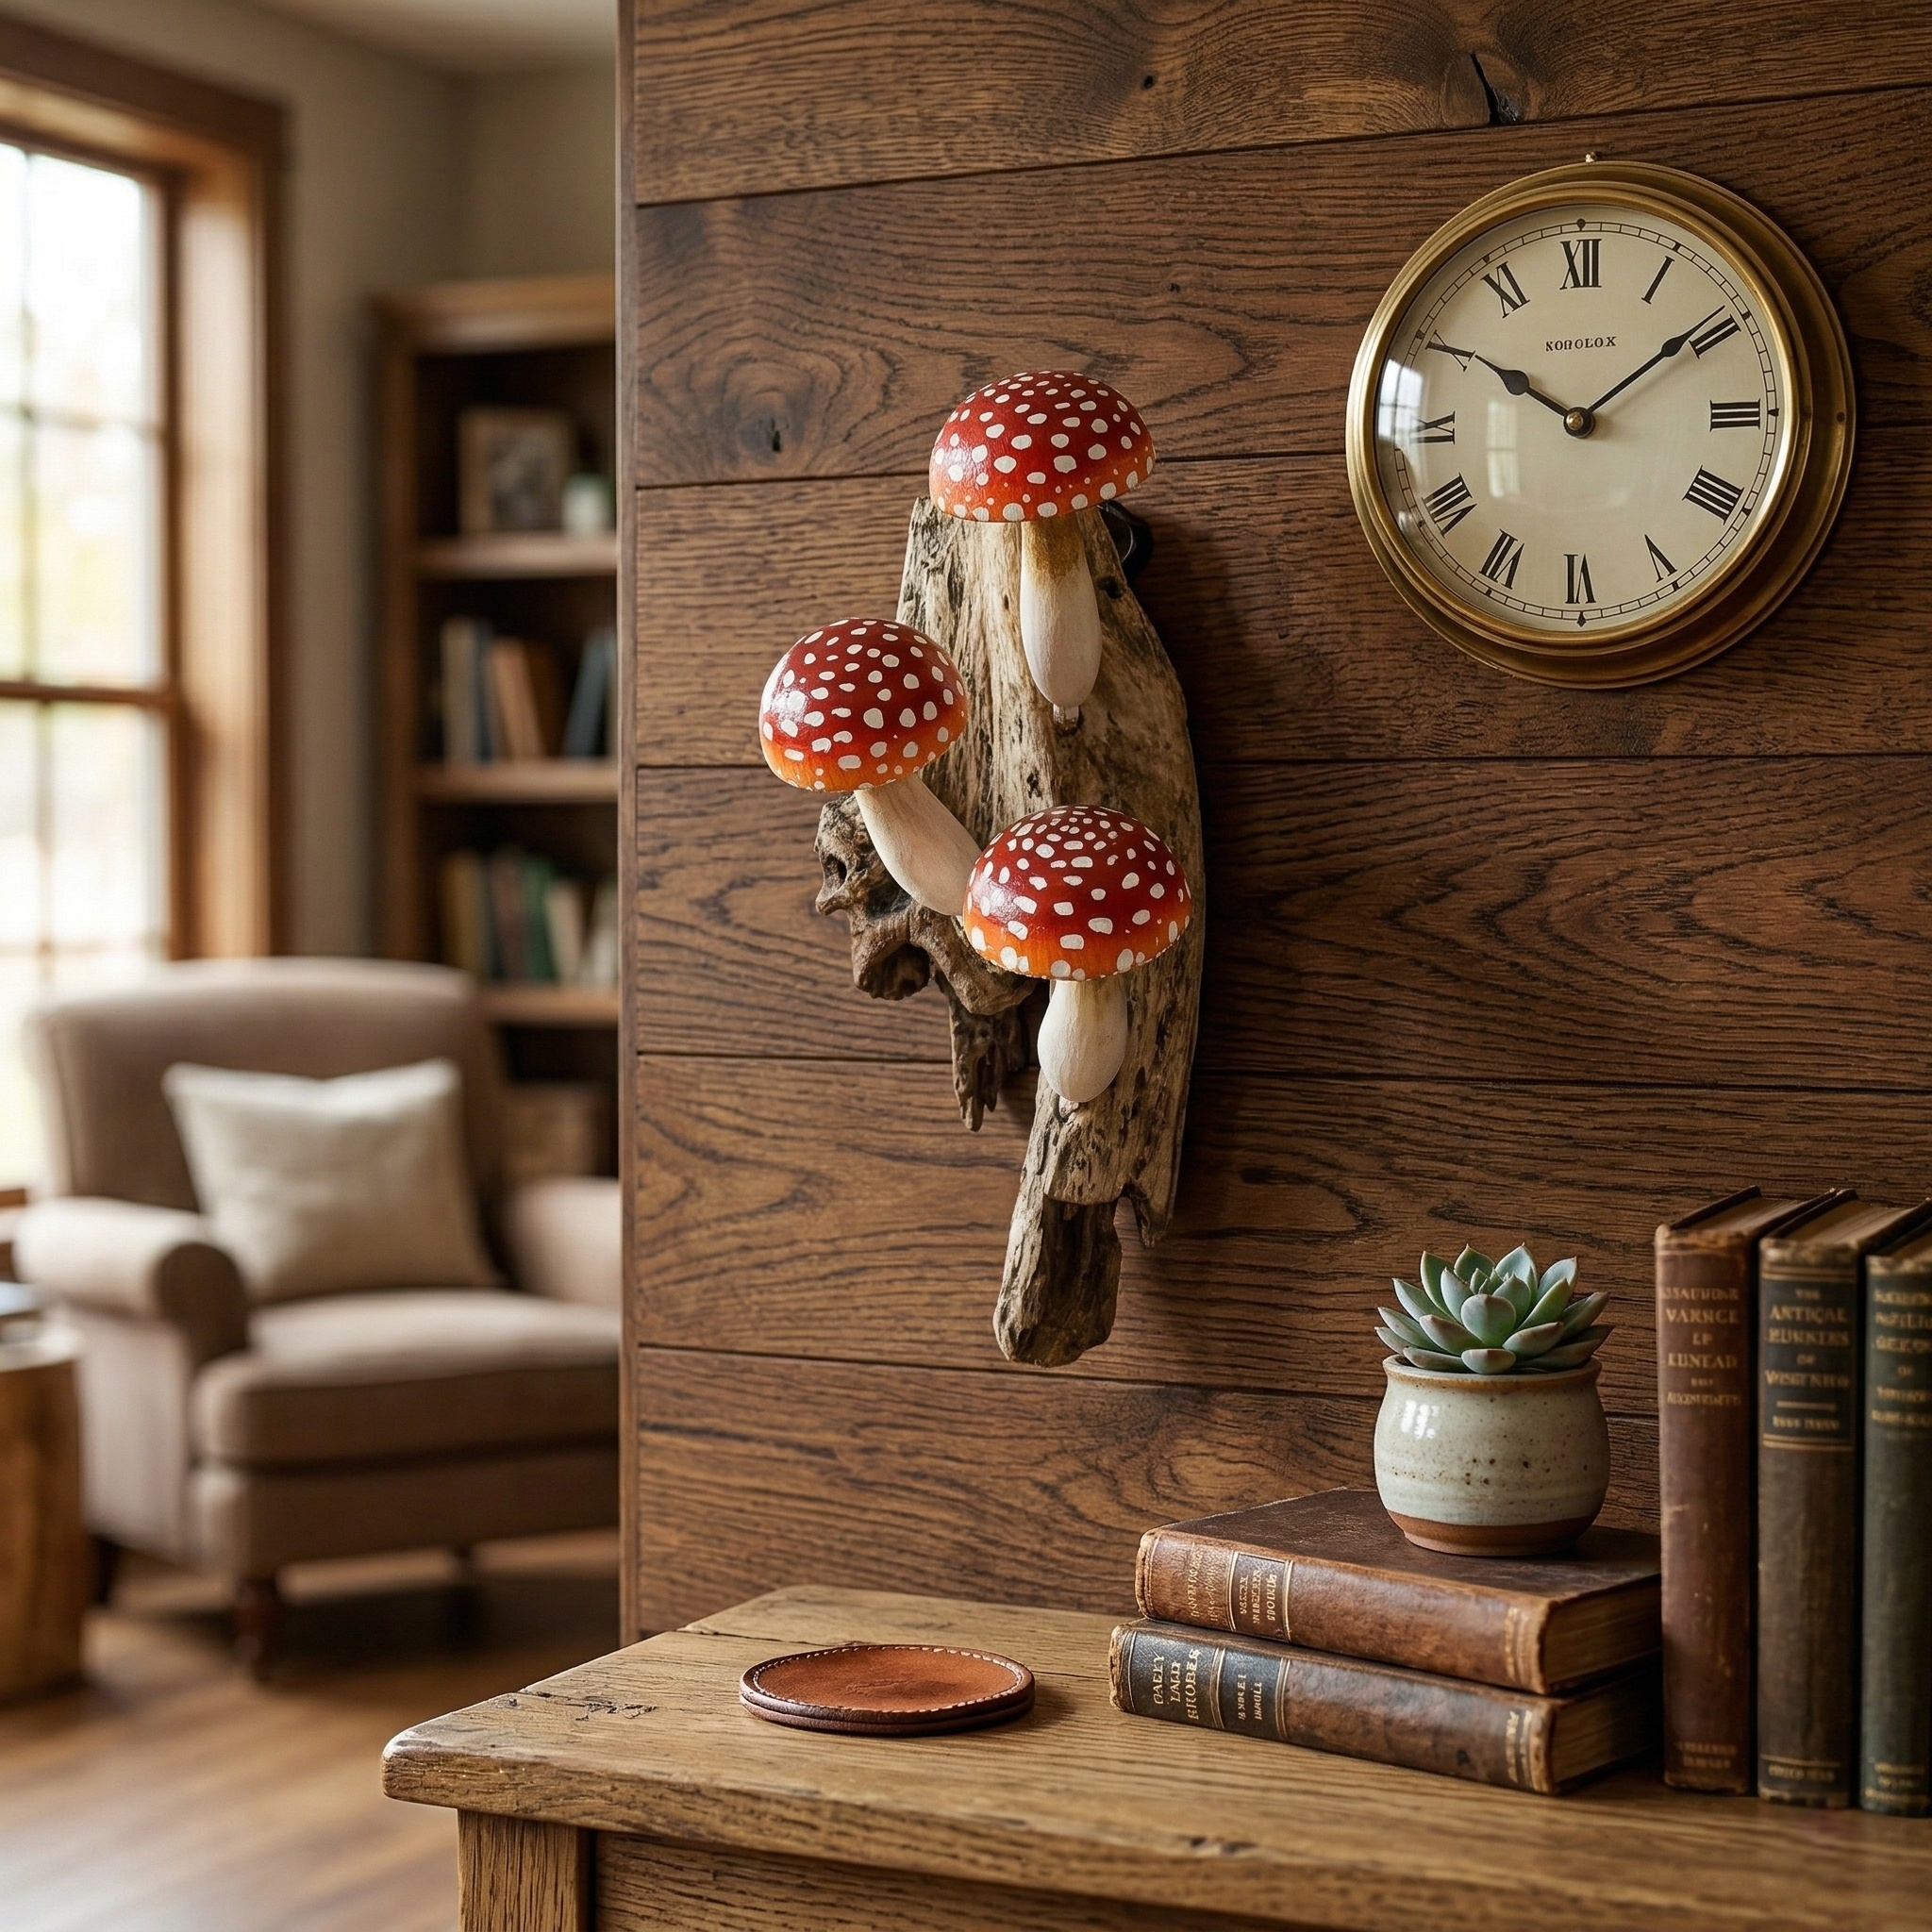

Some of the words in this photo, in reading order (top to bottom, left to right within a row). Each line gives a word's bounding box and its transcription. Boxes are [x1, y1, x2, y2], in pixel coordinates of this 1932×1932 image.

[1559, 238, 1602, 291] XII
[1641, 256, 1675, 305] I
[1481, 261, 1530, 319] XI
[1425, 330, 1476, 372] X
[1689, 314, 1741, 359] II
[1709, 398, 1761, 432] III
[1478, 528, 1525, 590] VII
[1644, 534, 1678, 582] V
